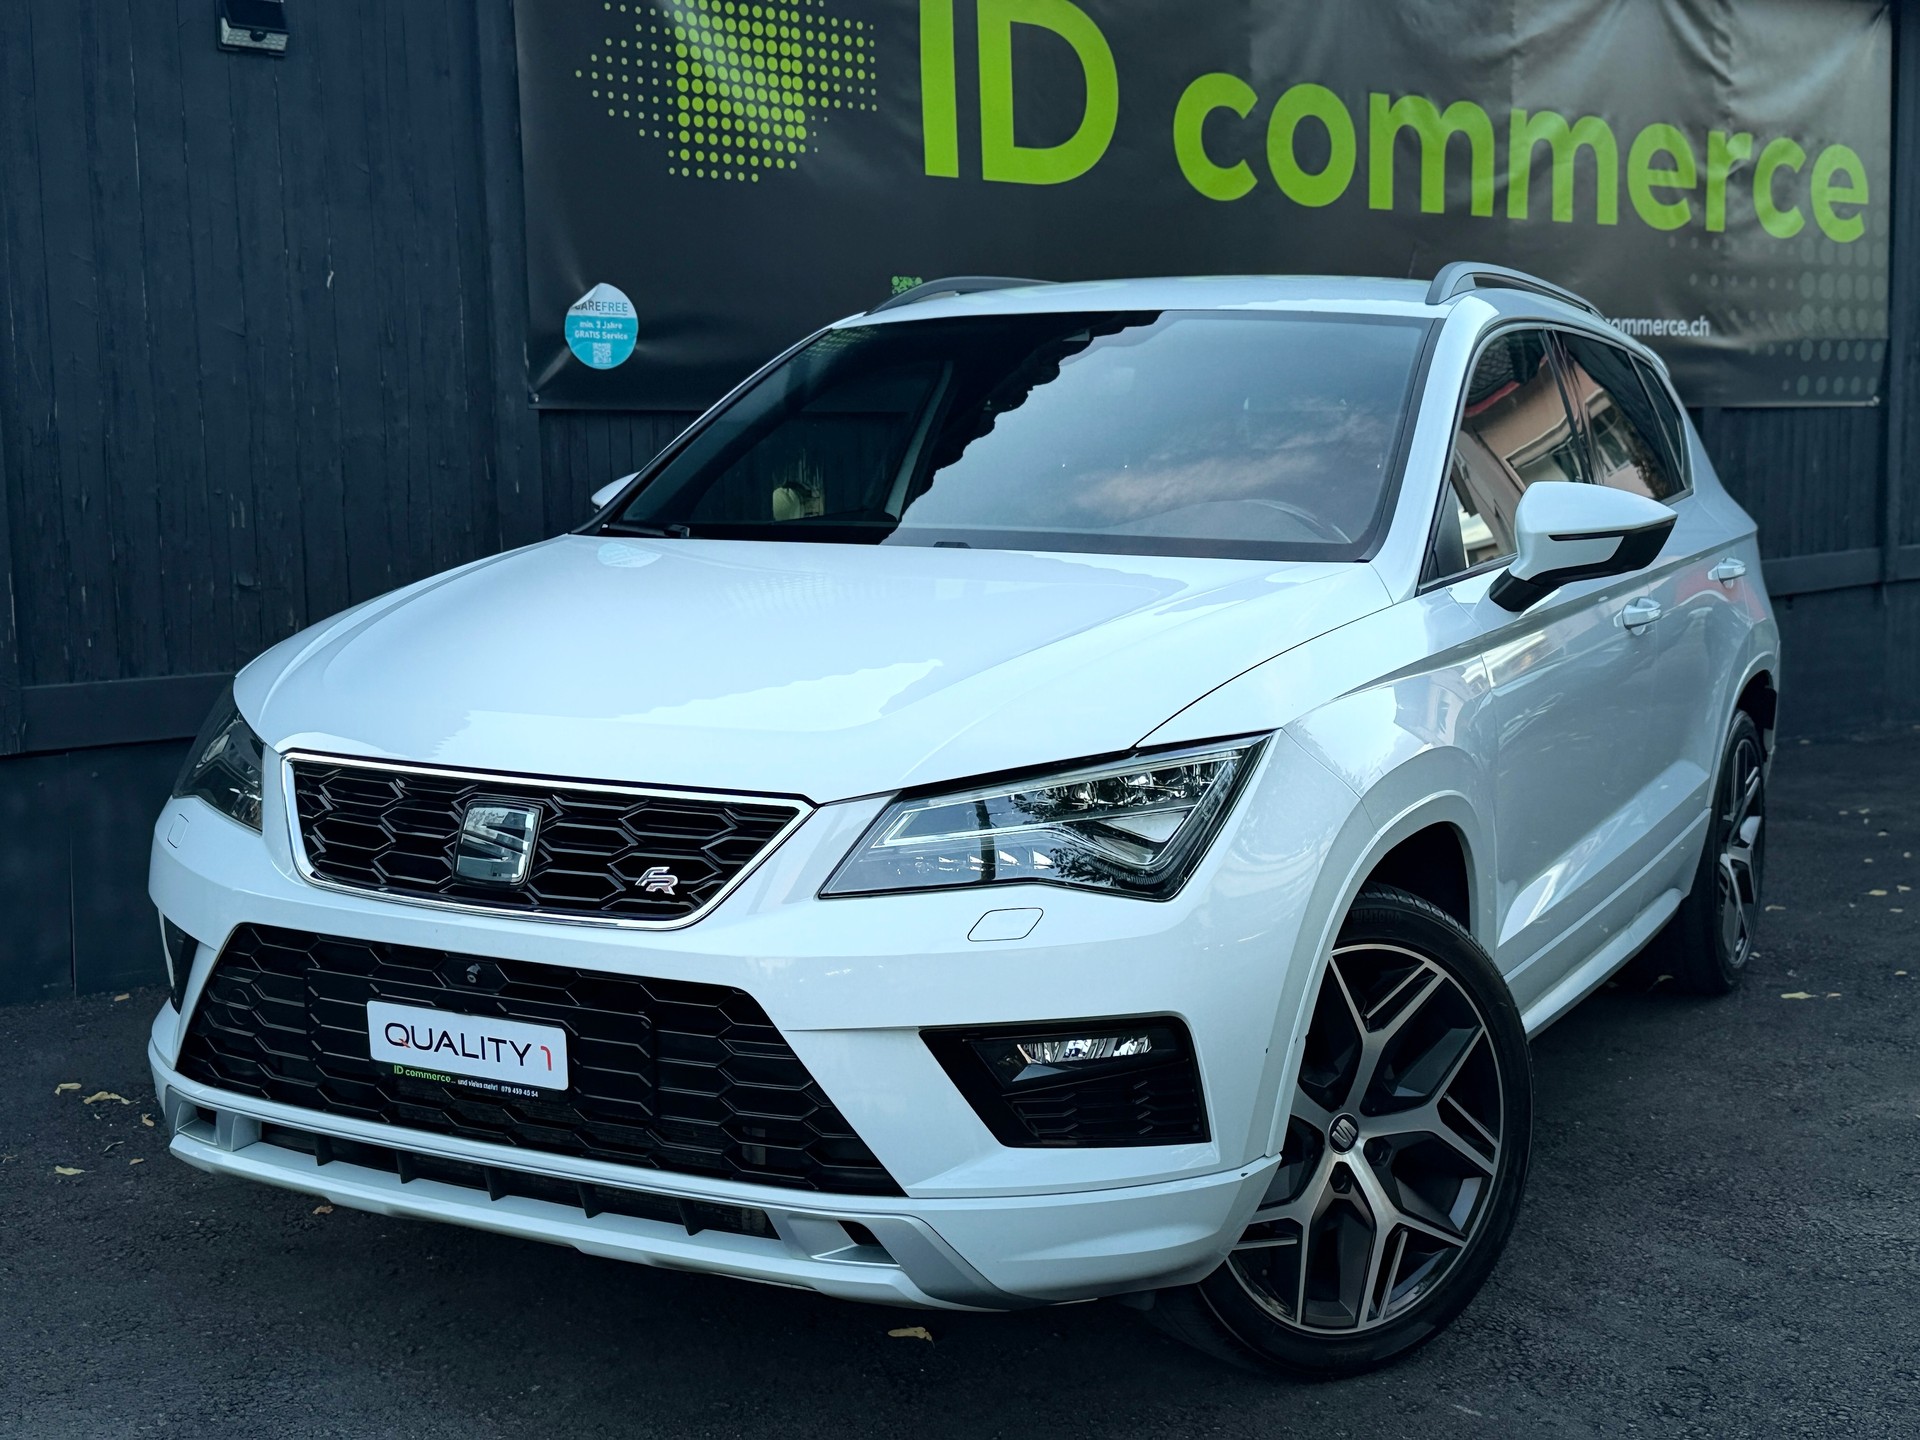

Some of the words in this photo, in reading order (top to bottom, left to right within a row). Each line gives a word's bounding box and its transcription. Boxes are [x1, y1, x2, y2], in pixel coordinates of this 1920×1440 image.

[919, 0, 1119, 185] ID
[1173, 72, 1869, 243] commerce
[602, 320, 622, 330] Jahre
[575, 330, 600, 339] GRATIS
[602, 331, 629, 341] Service
[384, 1022, 532, 1067] QUALITY
[394, 1064, 404, 1075] ID
